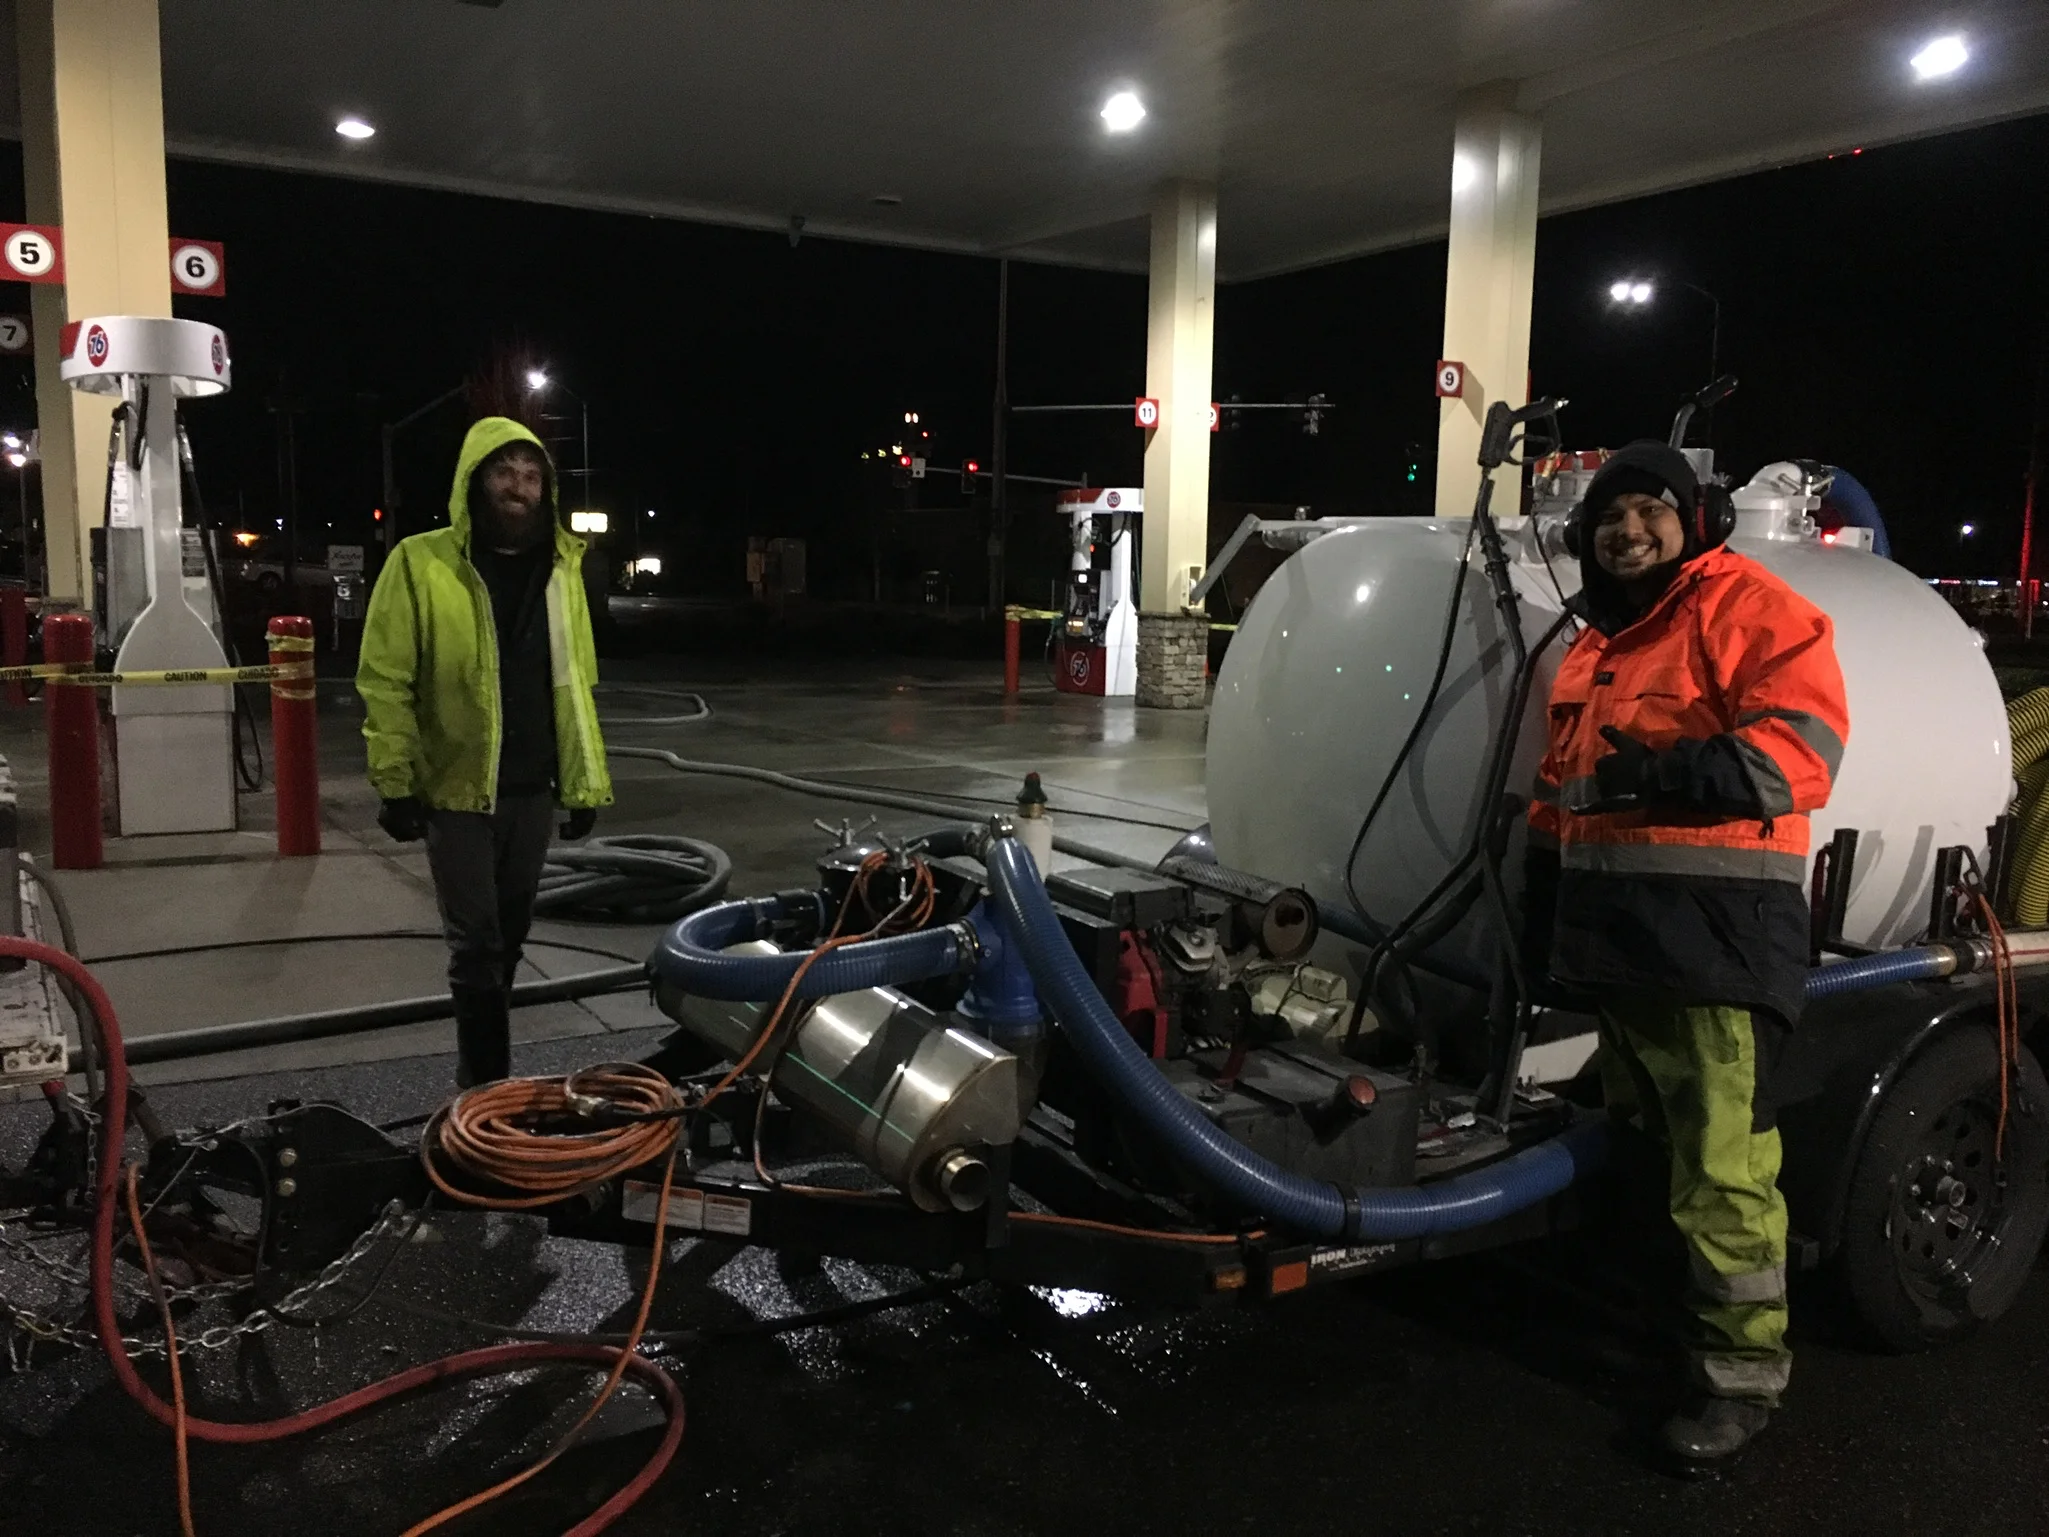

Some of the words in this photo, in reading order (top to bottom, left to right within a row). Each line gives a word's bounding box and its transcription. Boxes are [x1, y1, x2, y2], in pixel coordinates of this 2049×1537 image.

[20, 242, 40, 264] 5
[186, 256, 205, 278] 6
[3, 325, 17, 341] 7
[90, 332, 105, 356] 76
[1445, 371, 1454, 386] 9
[1142, 407, 1152, 418] 11
[164, 671, 207, 682] CAUTION
